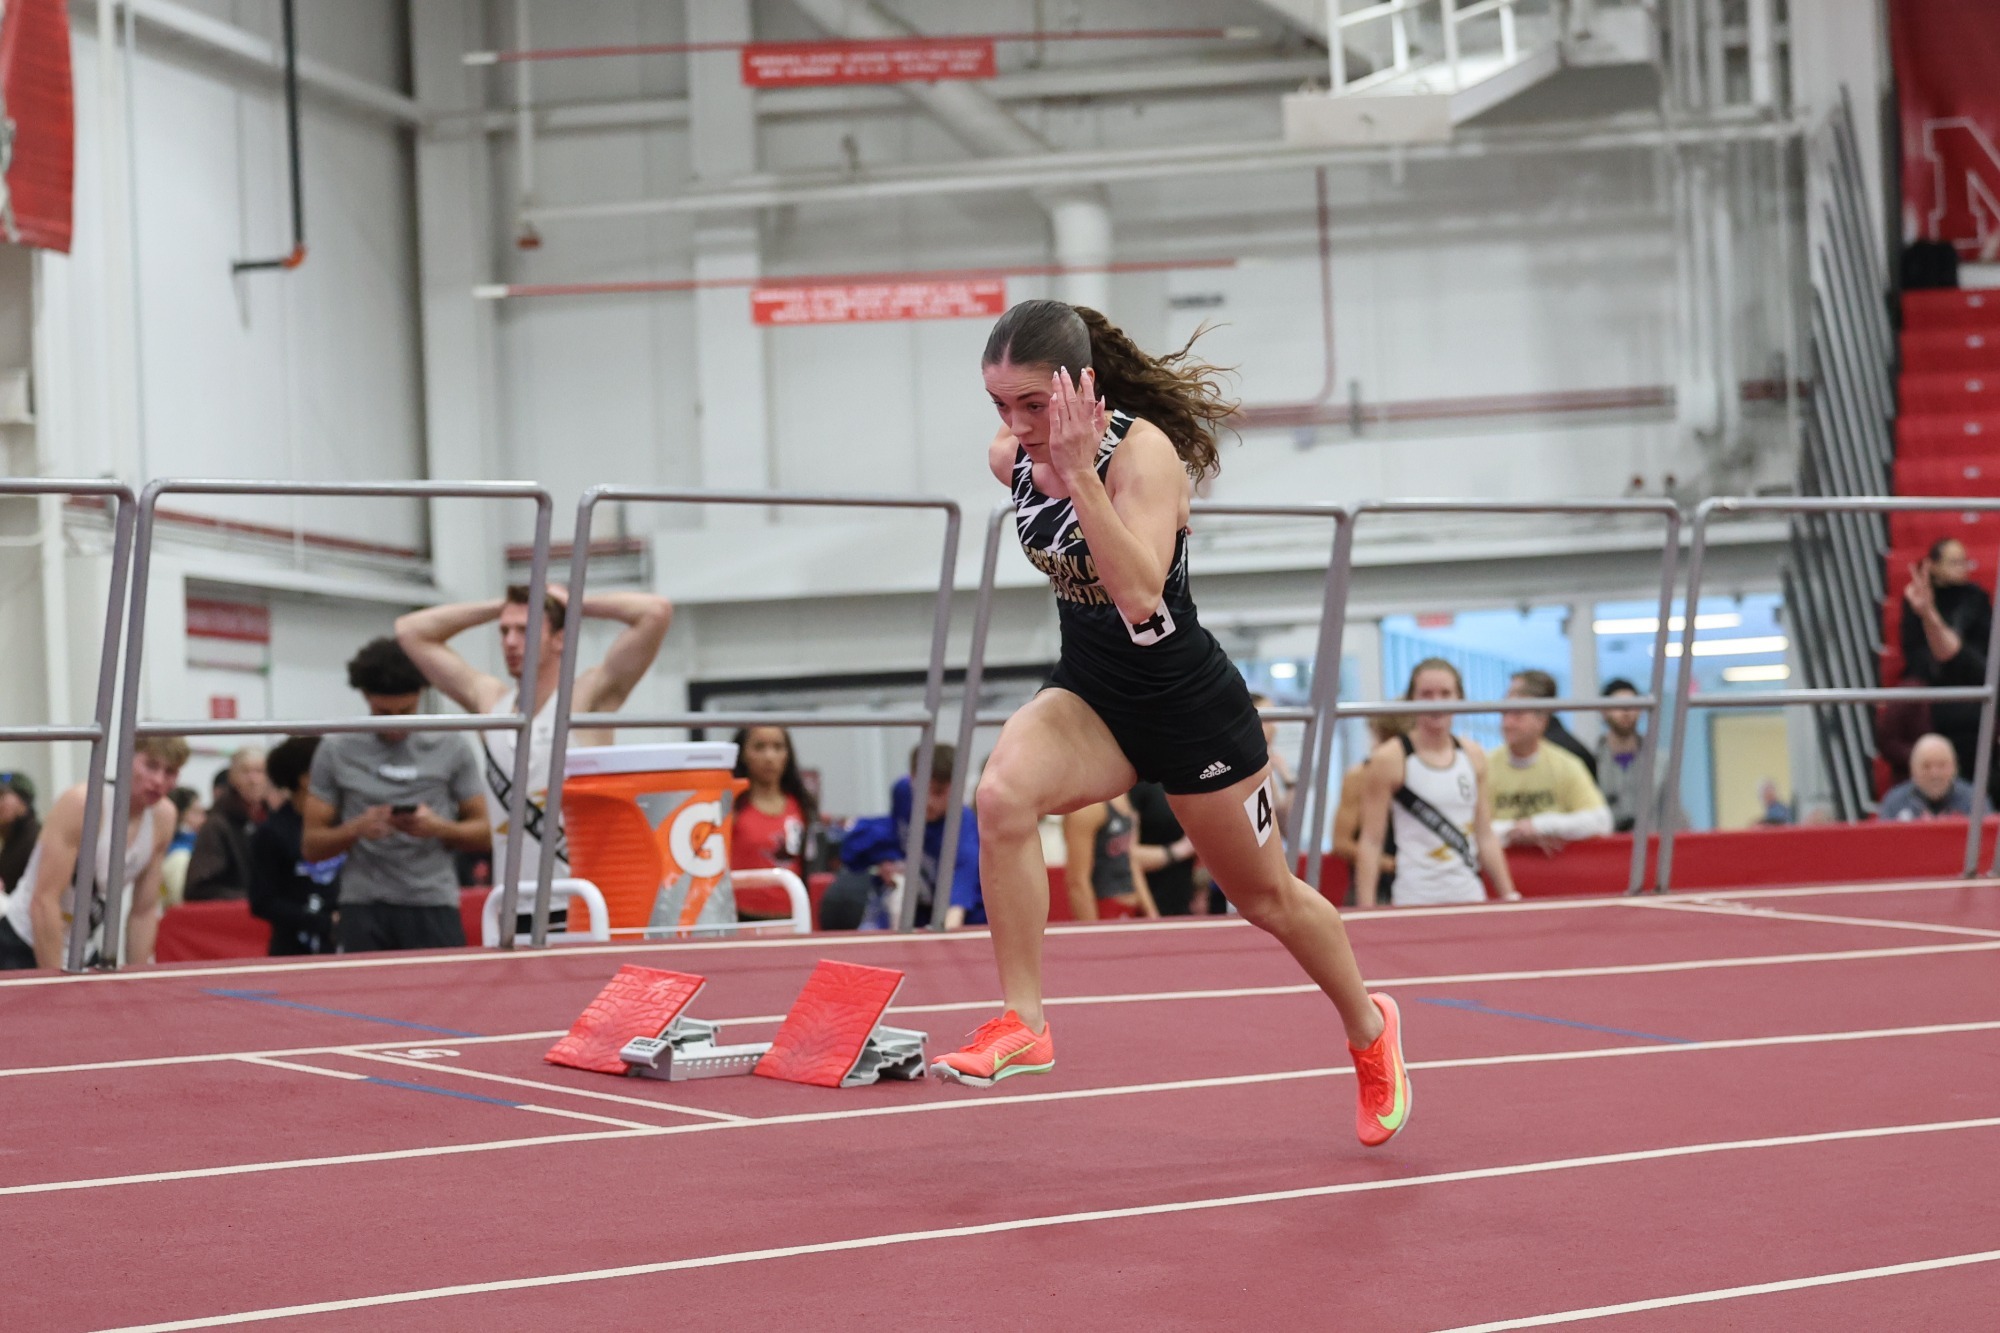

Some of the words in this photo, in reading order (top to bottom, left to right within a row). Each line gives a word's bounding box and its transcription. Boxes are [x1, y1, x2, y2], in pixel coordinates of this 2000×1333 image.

[1199, 765, 1232, 780] adidas
[1257, 785, 1272, 834] 4
[669, 801, 727, 878] G
